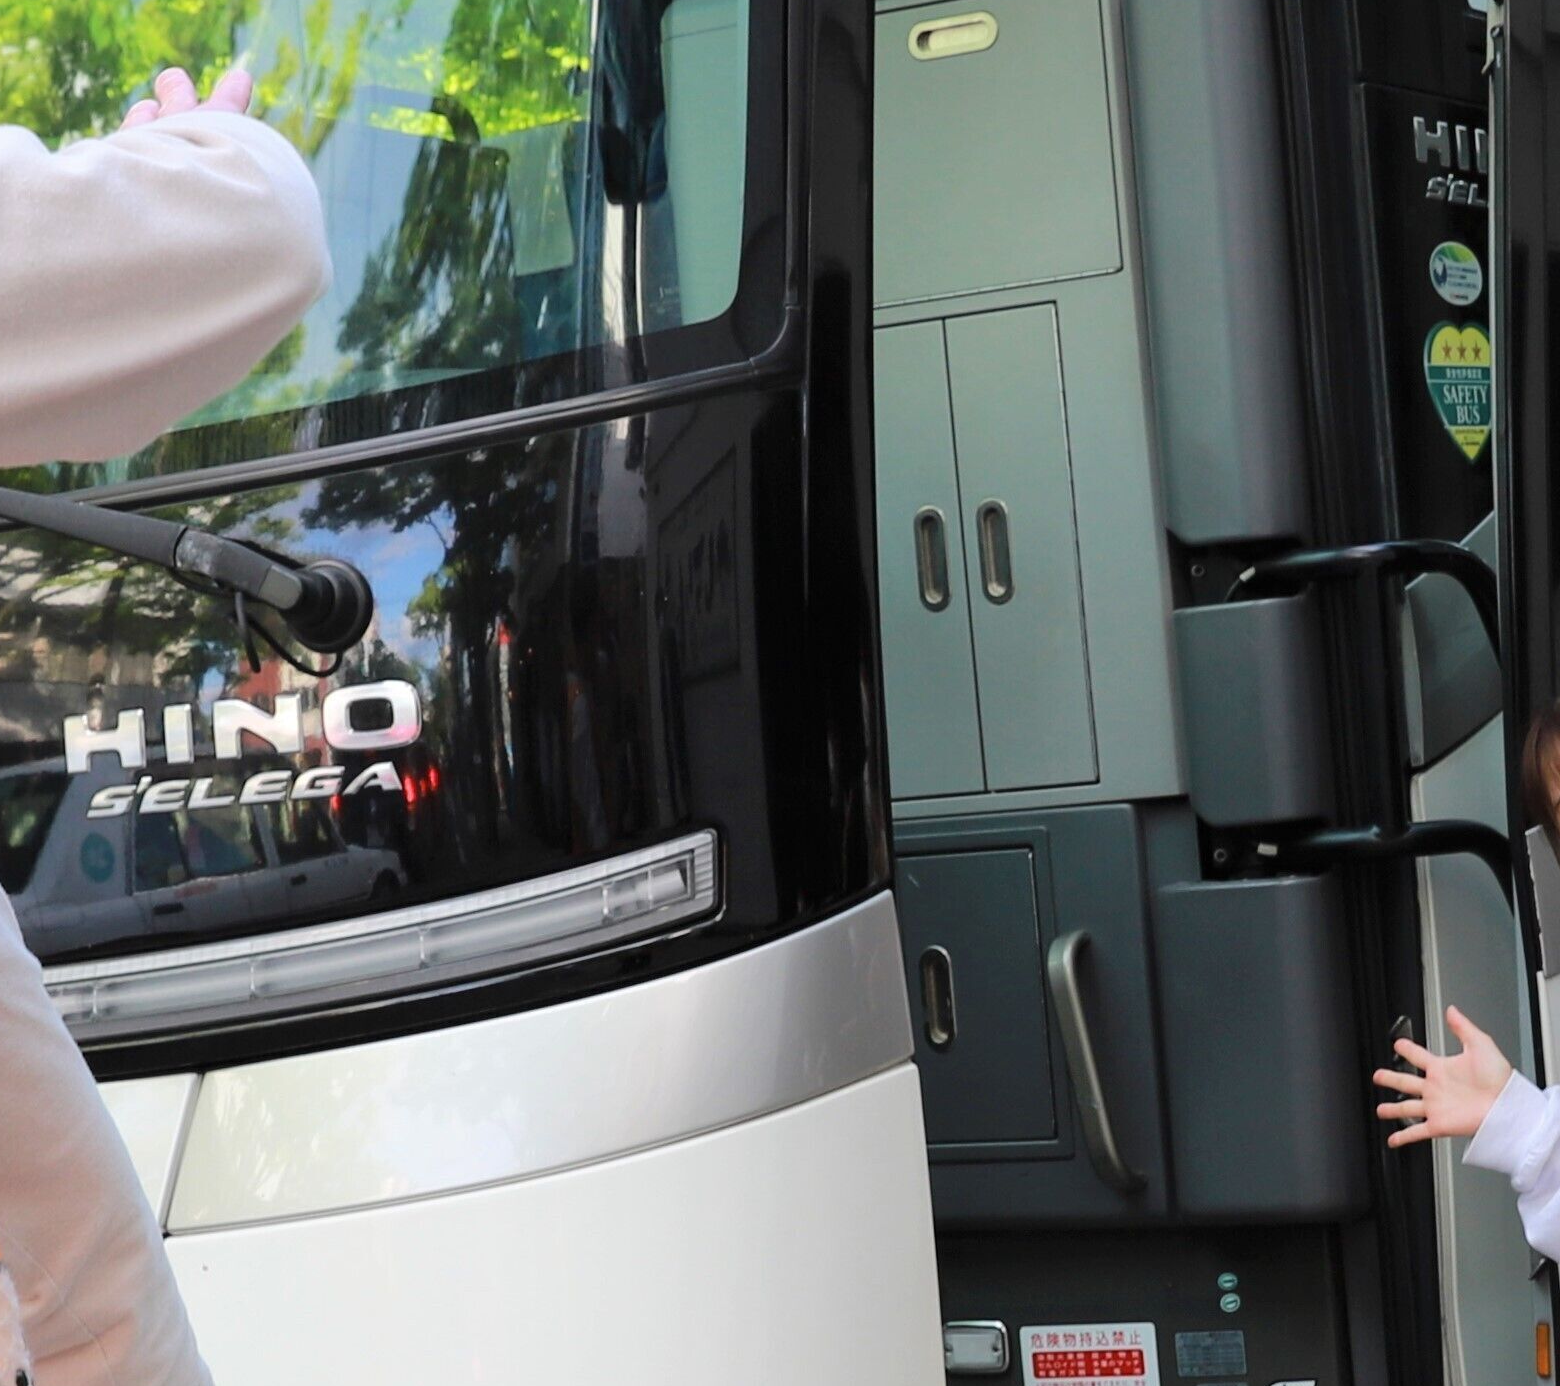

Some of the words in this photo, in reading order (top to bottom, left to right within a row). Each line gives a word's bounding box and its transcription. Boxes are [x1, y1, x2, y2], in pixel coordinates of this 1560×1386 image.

[1443, 383, 1487, 404] SAFETY
[1456, 403, 1481, 425] BUS
[65, 679, 421, 773] HINO
[1031, 1330, 1142, 1349] 危険物持込禁止
